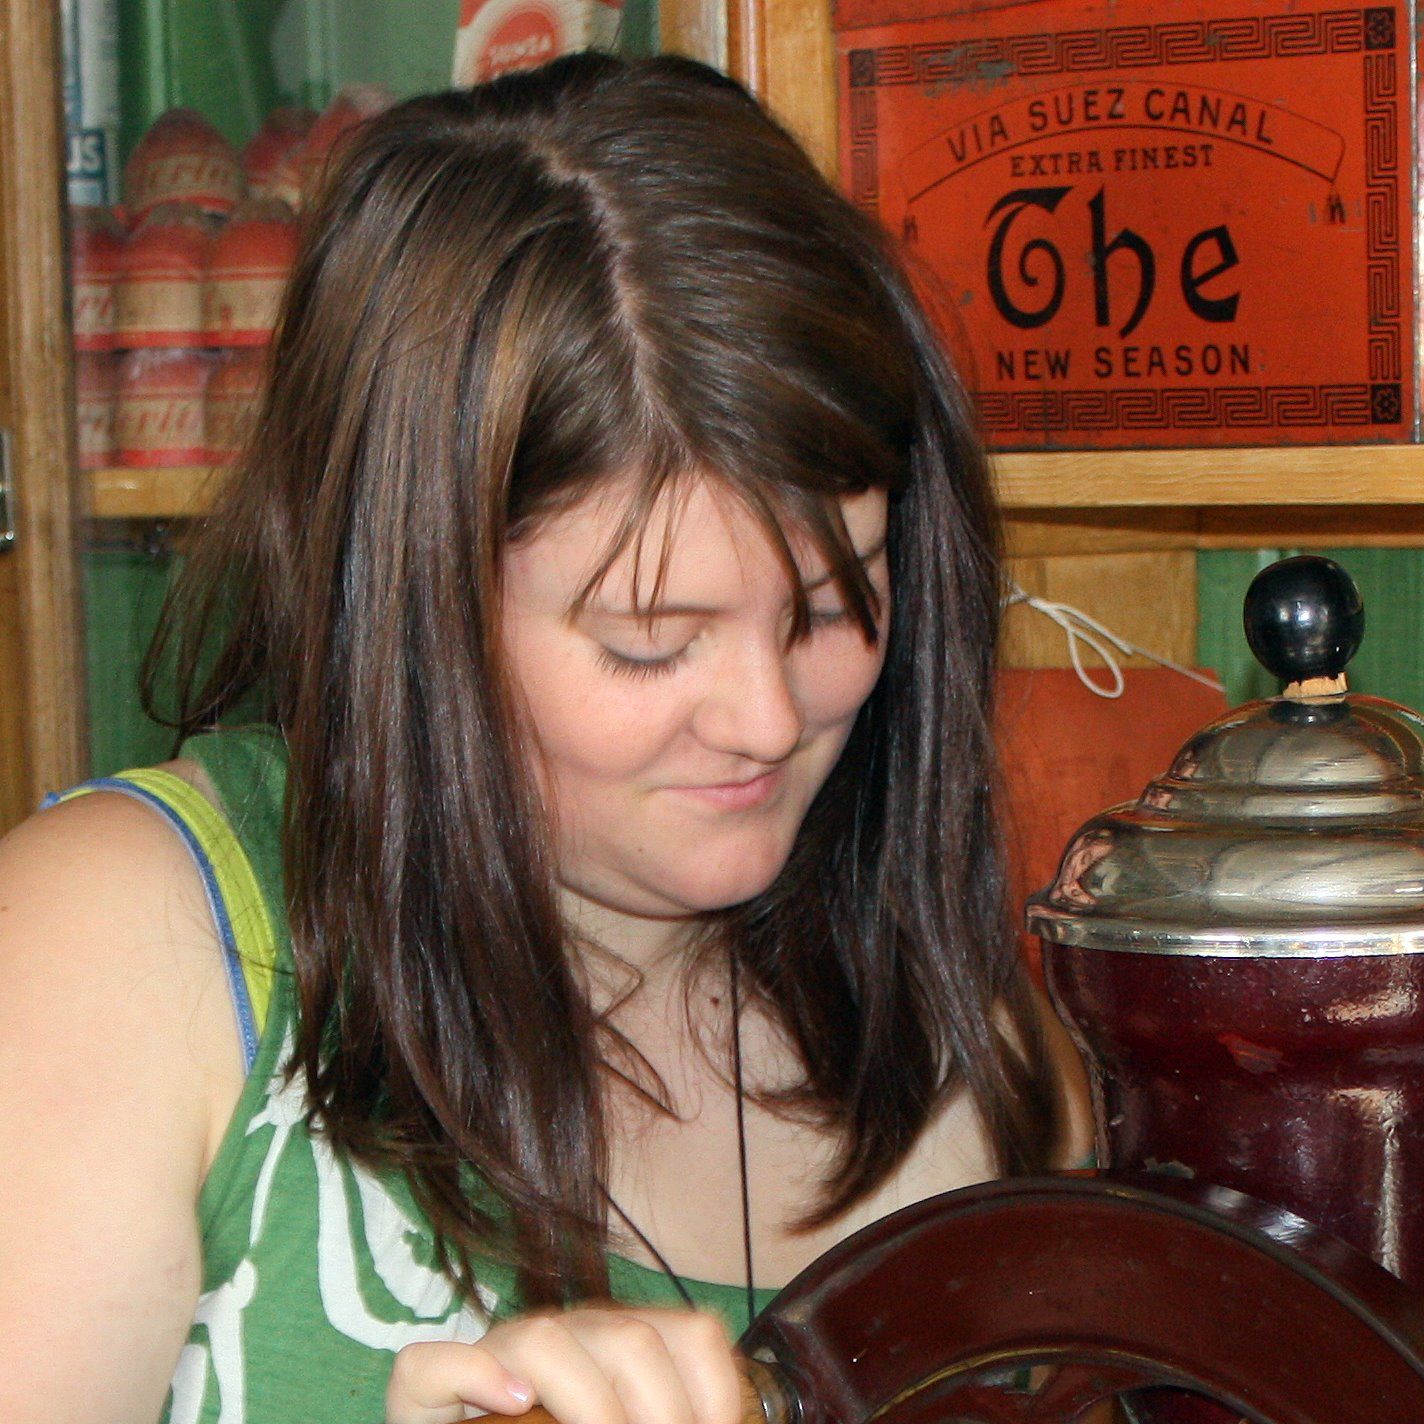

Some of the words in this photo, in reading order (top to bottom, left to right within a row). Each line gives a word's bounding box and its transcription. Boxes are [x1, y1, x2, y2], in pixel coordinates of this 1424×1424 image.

[948, 115, 1009, 163] VIA
[1029, 87, 1126, 132] SUEZ
[1145, 88, 1276, 146] CANAL
[1009, 149, 1104, 178] EXTRA
[1114, 144, 1215, 172] FINEST
[986, 185, 1242, 339] The
[995, 348, 1073, 381] NEW
[1094, 343, 1252, 379] SEASON
